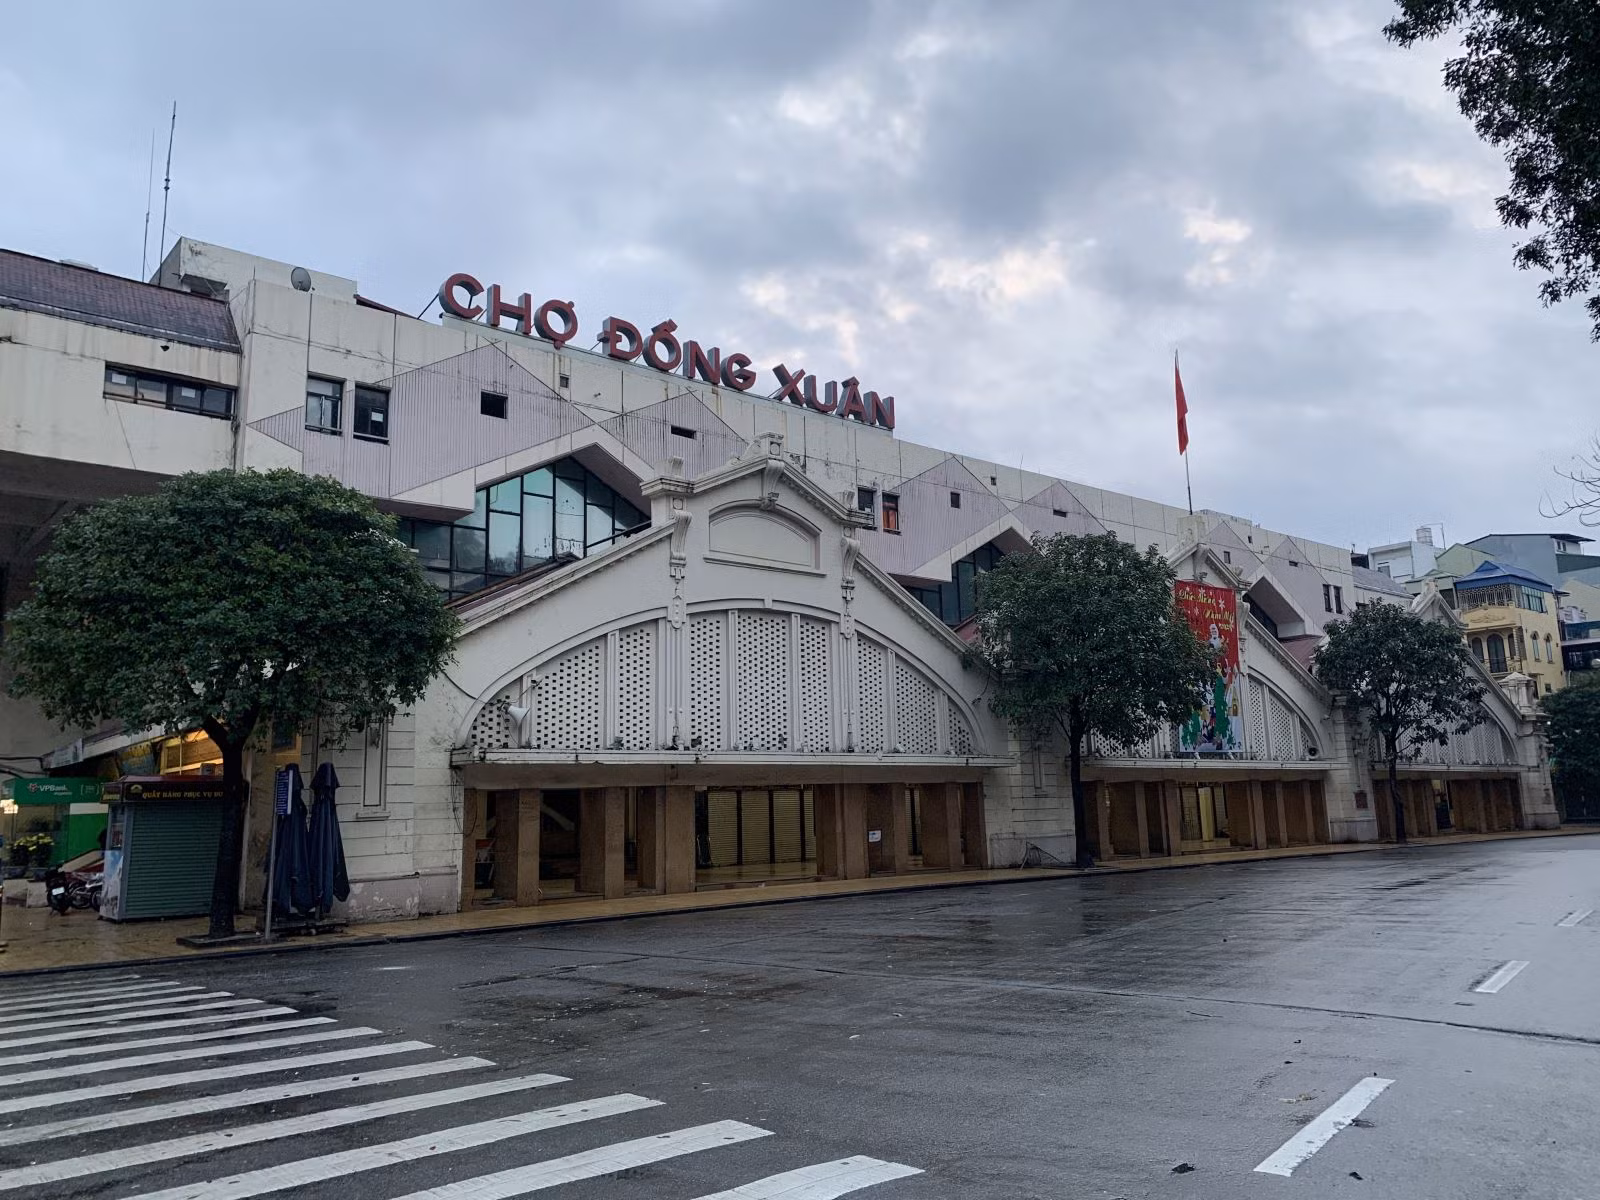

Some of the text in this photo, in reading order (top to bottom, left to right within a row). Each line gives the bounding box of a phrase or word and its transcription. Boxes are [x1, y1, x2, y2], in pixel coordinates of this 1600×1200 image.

[438, 272, 896, 429] CHỢ ĐỒNG XUÂN
[39, 784, 68, 792] VPBank
